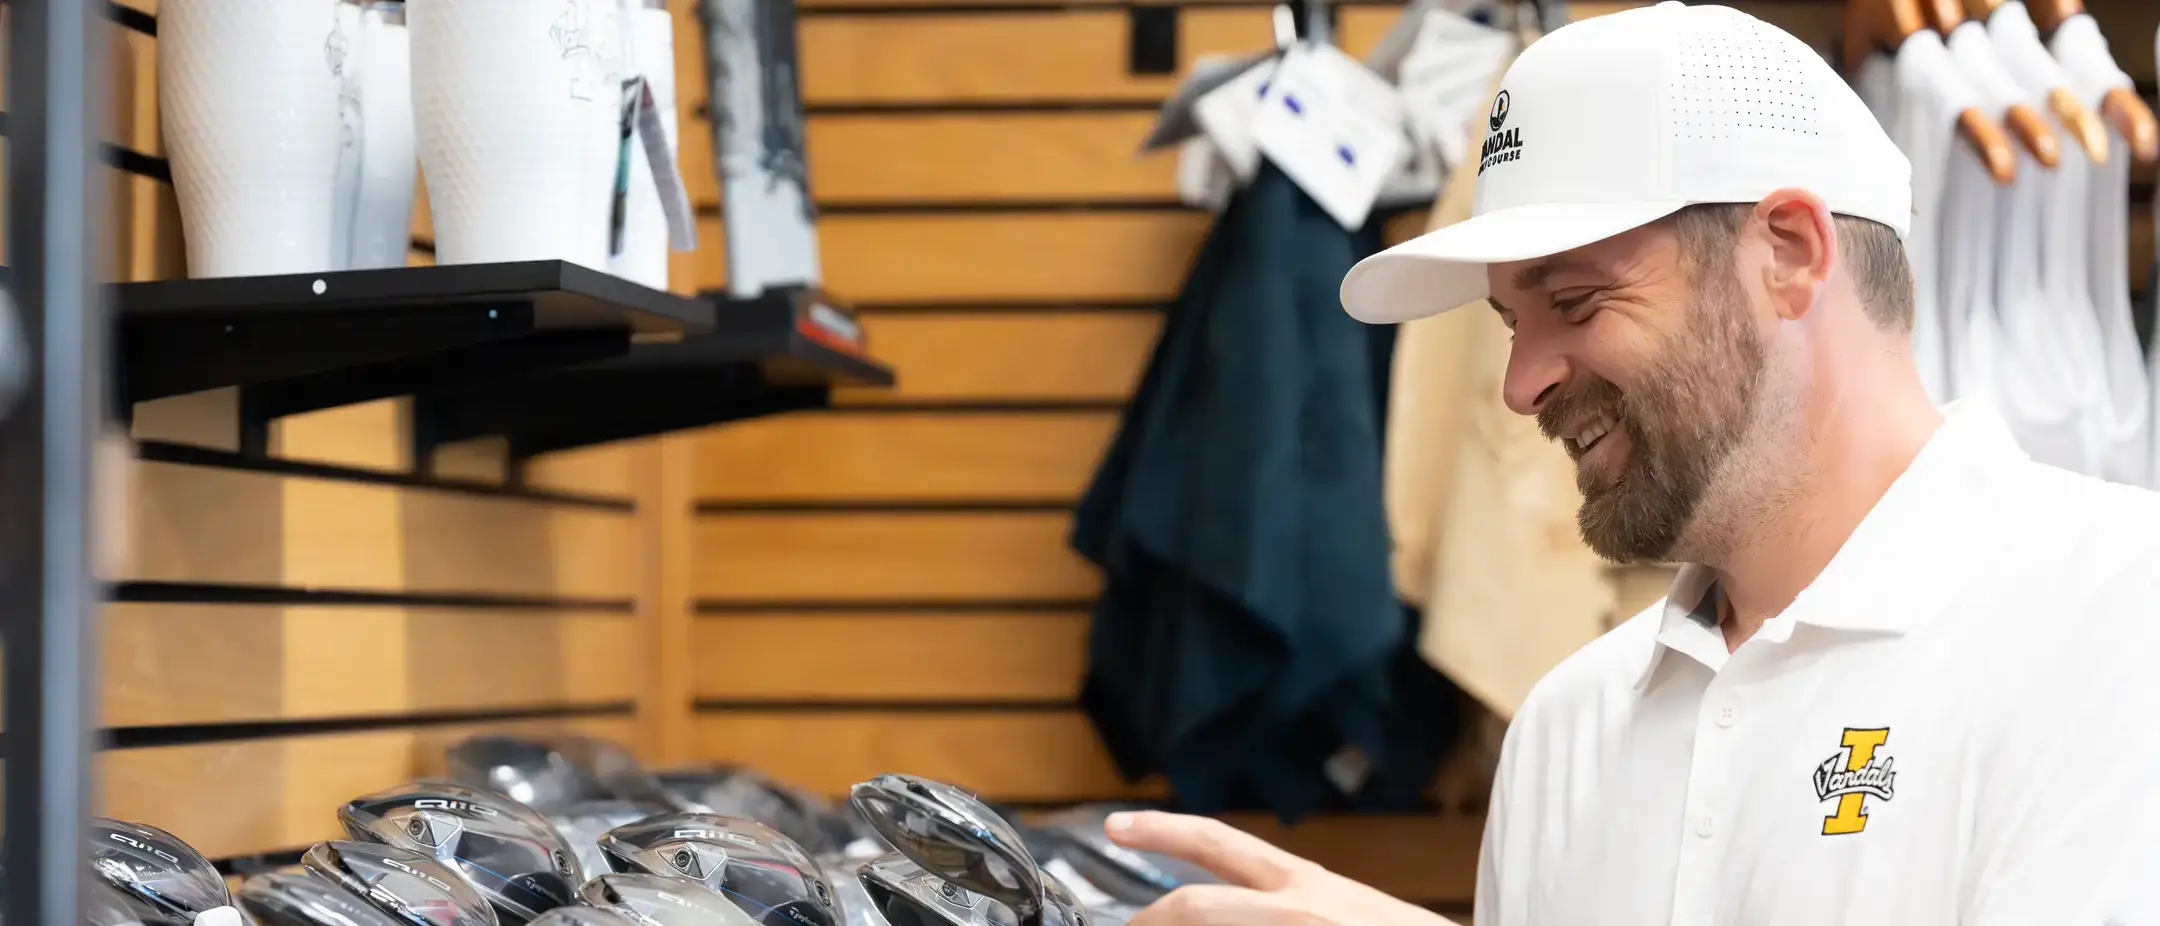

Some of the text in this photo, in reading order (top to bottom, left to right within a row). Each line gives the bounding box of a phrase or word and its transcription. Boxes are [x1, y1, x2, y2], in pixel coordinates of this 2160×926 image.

[1487, 149, 1521, 168] COURSE
[1812, 752, 1897, 803] Vandals
[110, 833, 179, 864] Qi10
